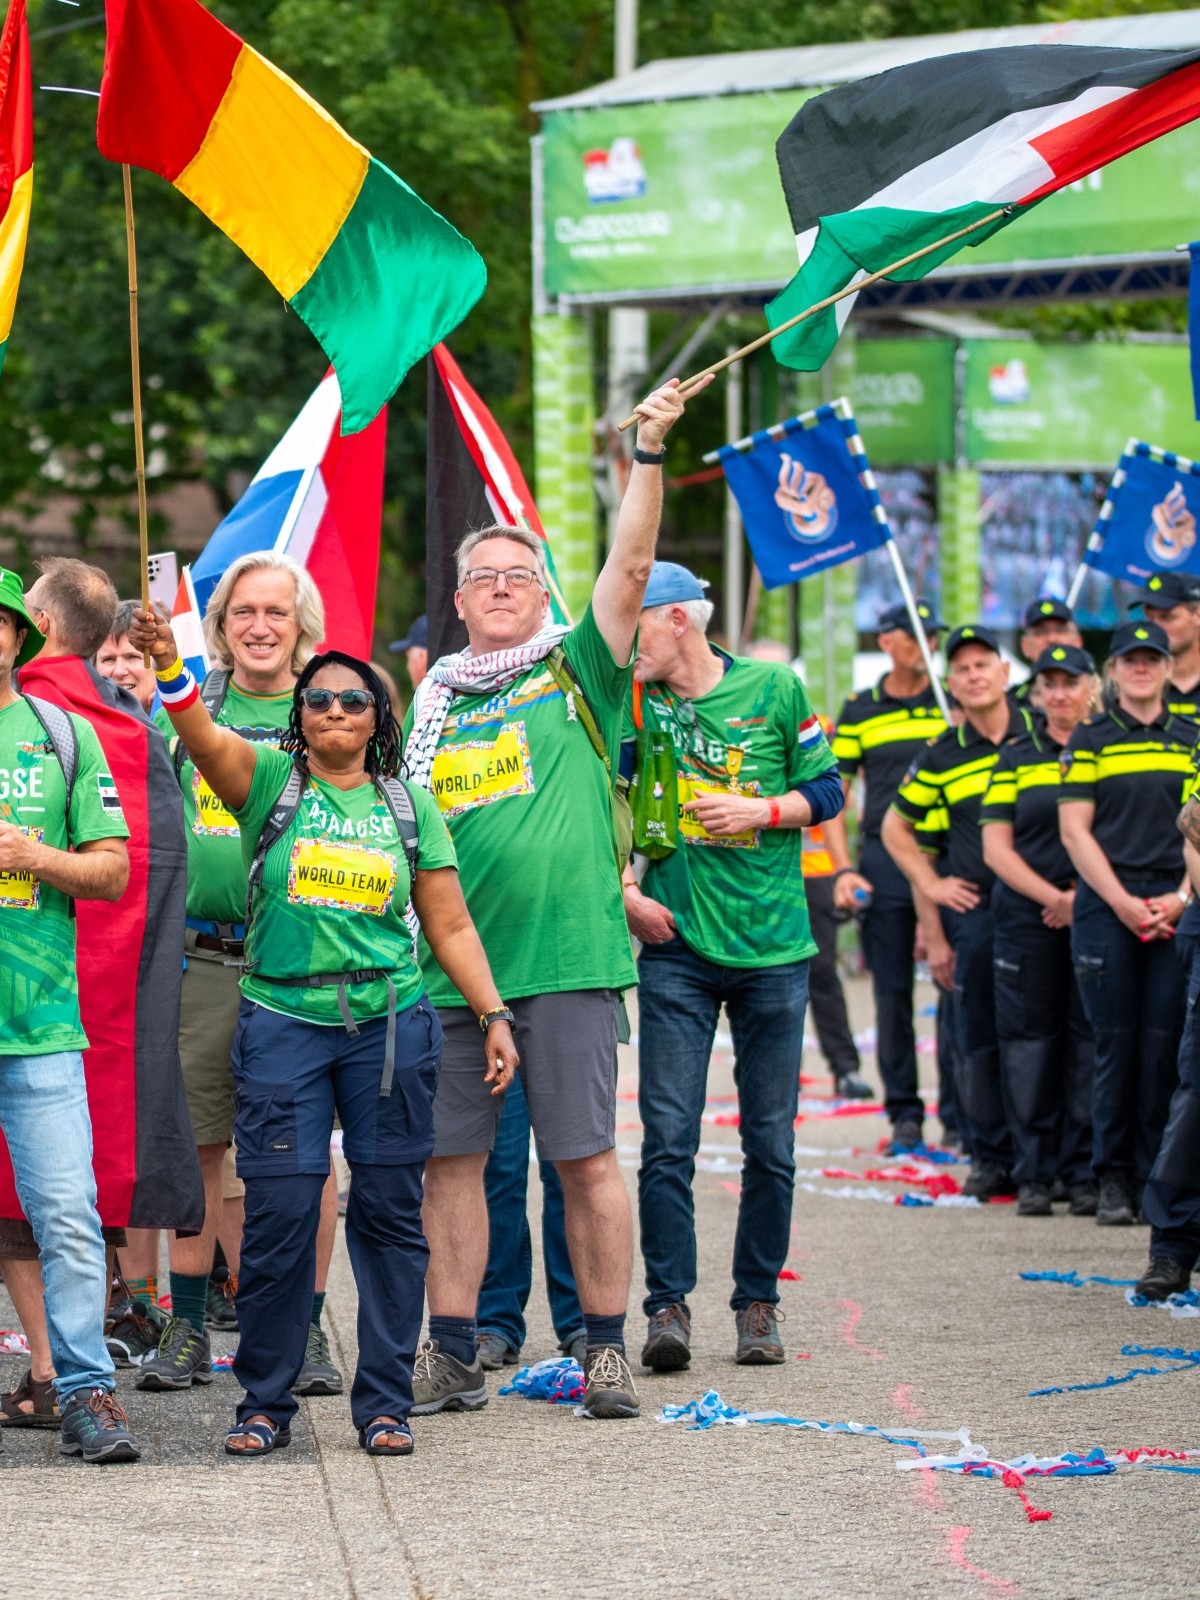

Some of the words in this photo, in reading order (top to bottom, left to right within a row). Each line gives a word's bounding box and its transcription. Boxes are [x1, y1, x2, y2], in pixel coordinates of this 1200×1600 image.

[434, 773, 482, 797] WORLD
[487, 755, 519, 778] EAM
[298, 865, 345, 885] WORLD
[351, 872, 388, 894] TEAM
